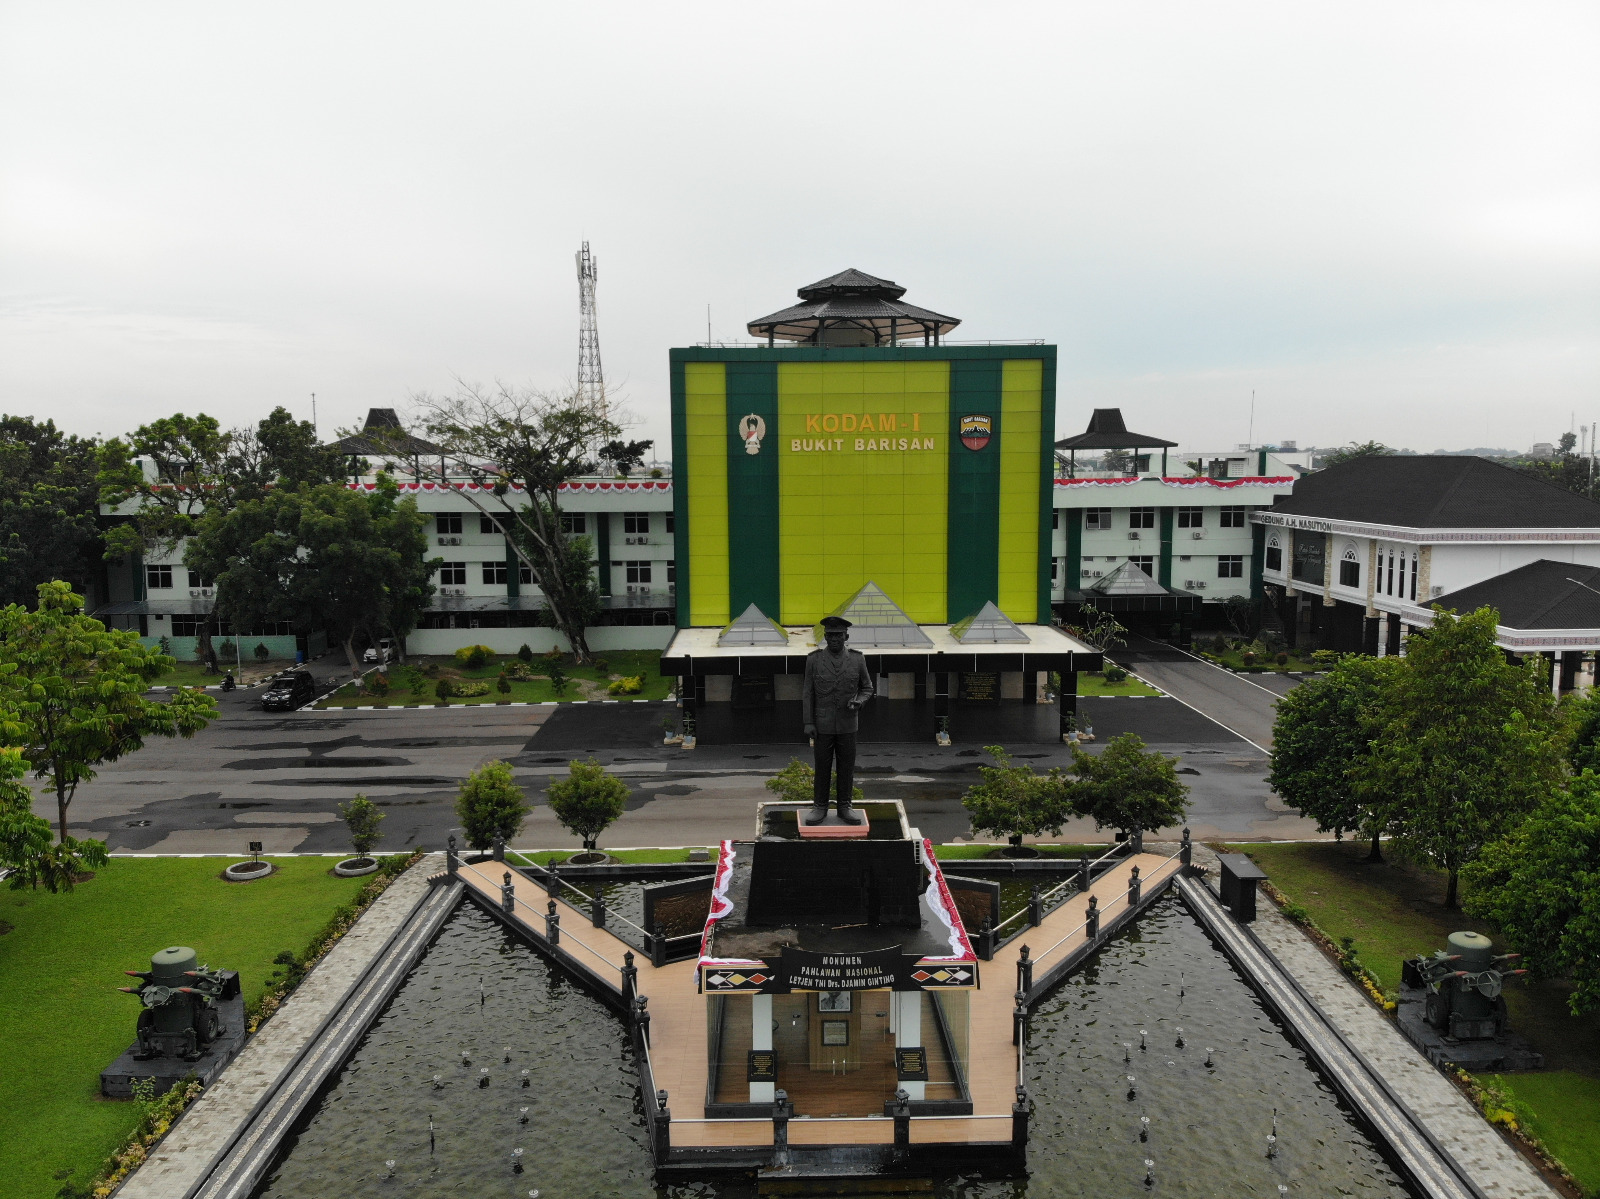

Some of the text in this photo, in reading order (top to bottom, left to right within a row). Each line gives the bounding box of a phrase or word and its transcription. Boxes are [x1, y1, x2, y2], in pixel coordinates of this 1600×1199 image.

[791, 438, 934, 452] BUKIT BARISAN
[1260, 514, 1284, 526] GEDUNG
[1299, 519, 1332, 532] NASUTION
[822, 956, 862, 965] MONUMEN
[801, 965, 883, 977] PAHLAWAN NASIONAL
[789, 974, 895, 988] LETJEN TNI Drs. DJAMIN GINTING
